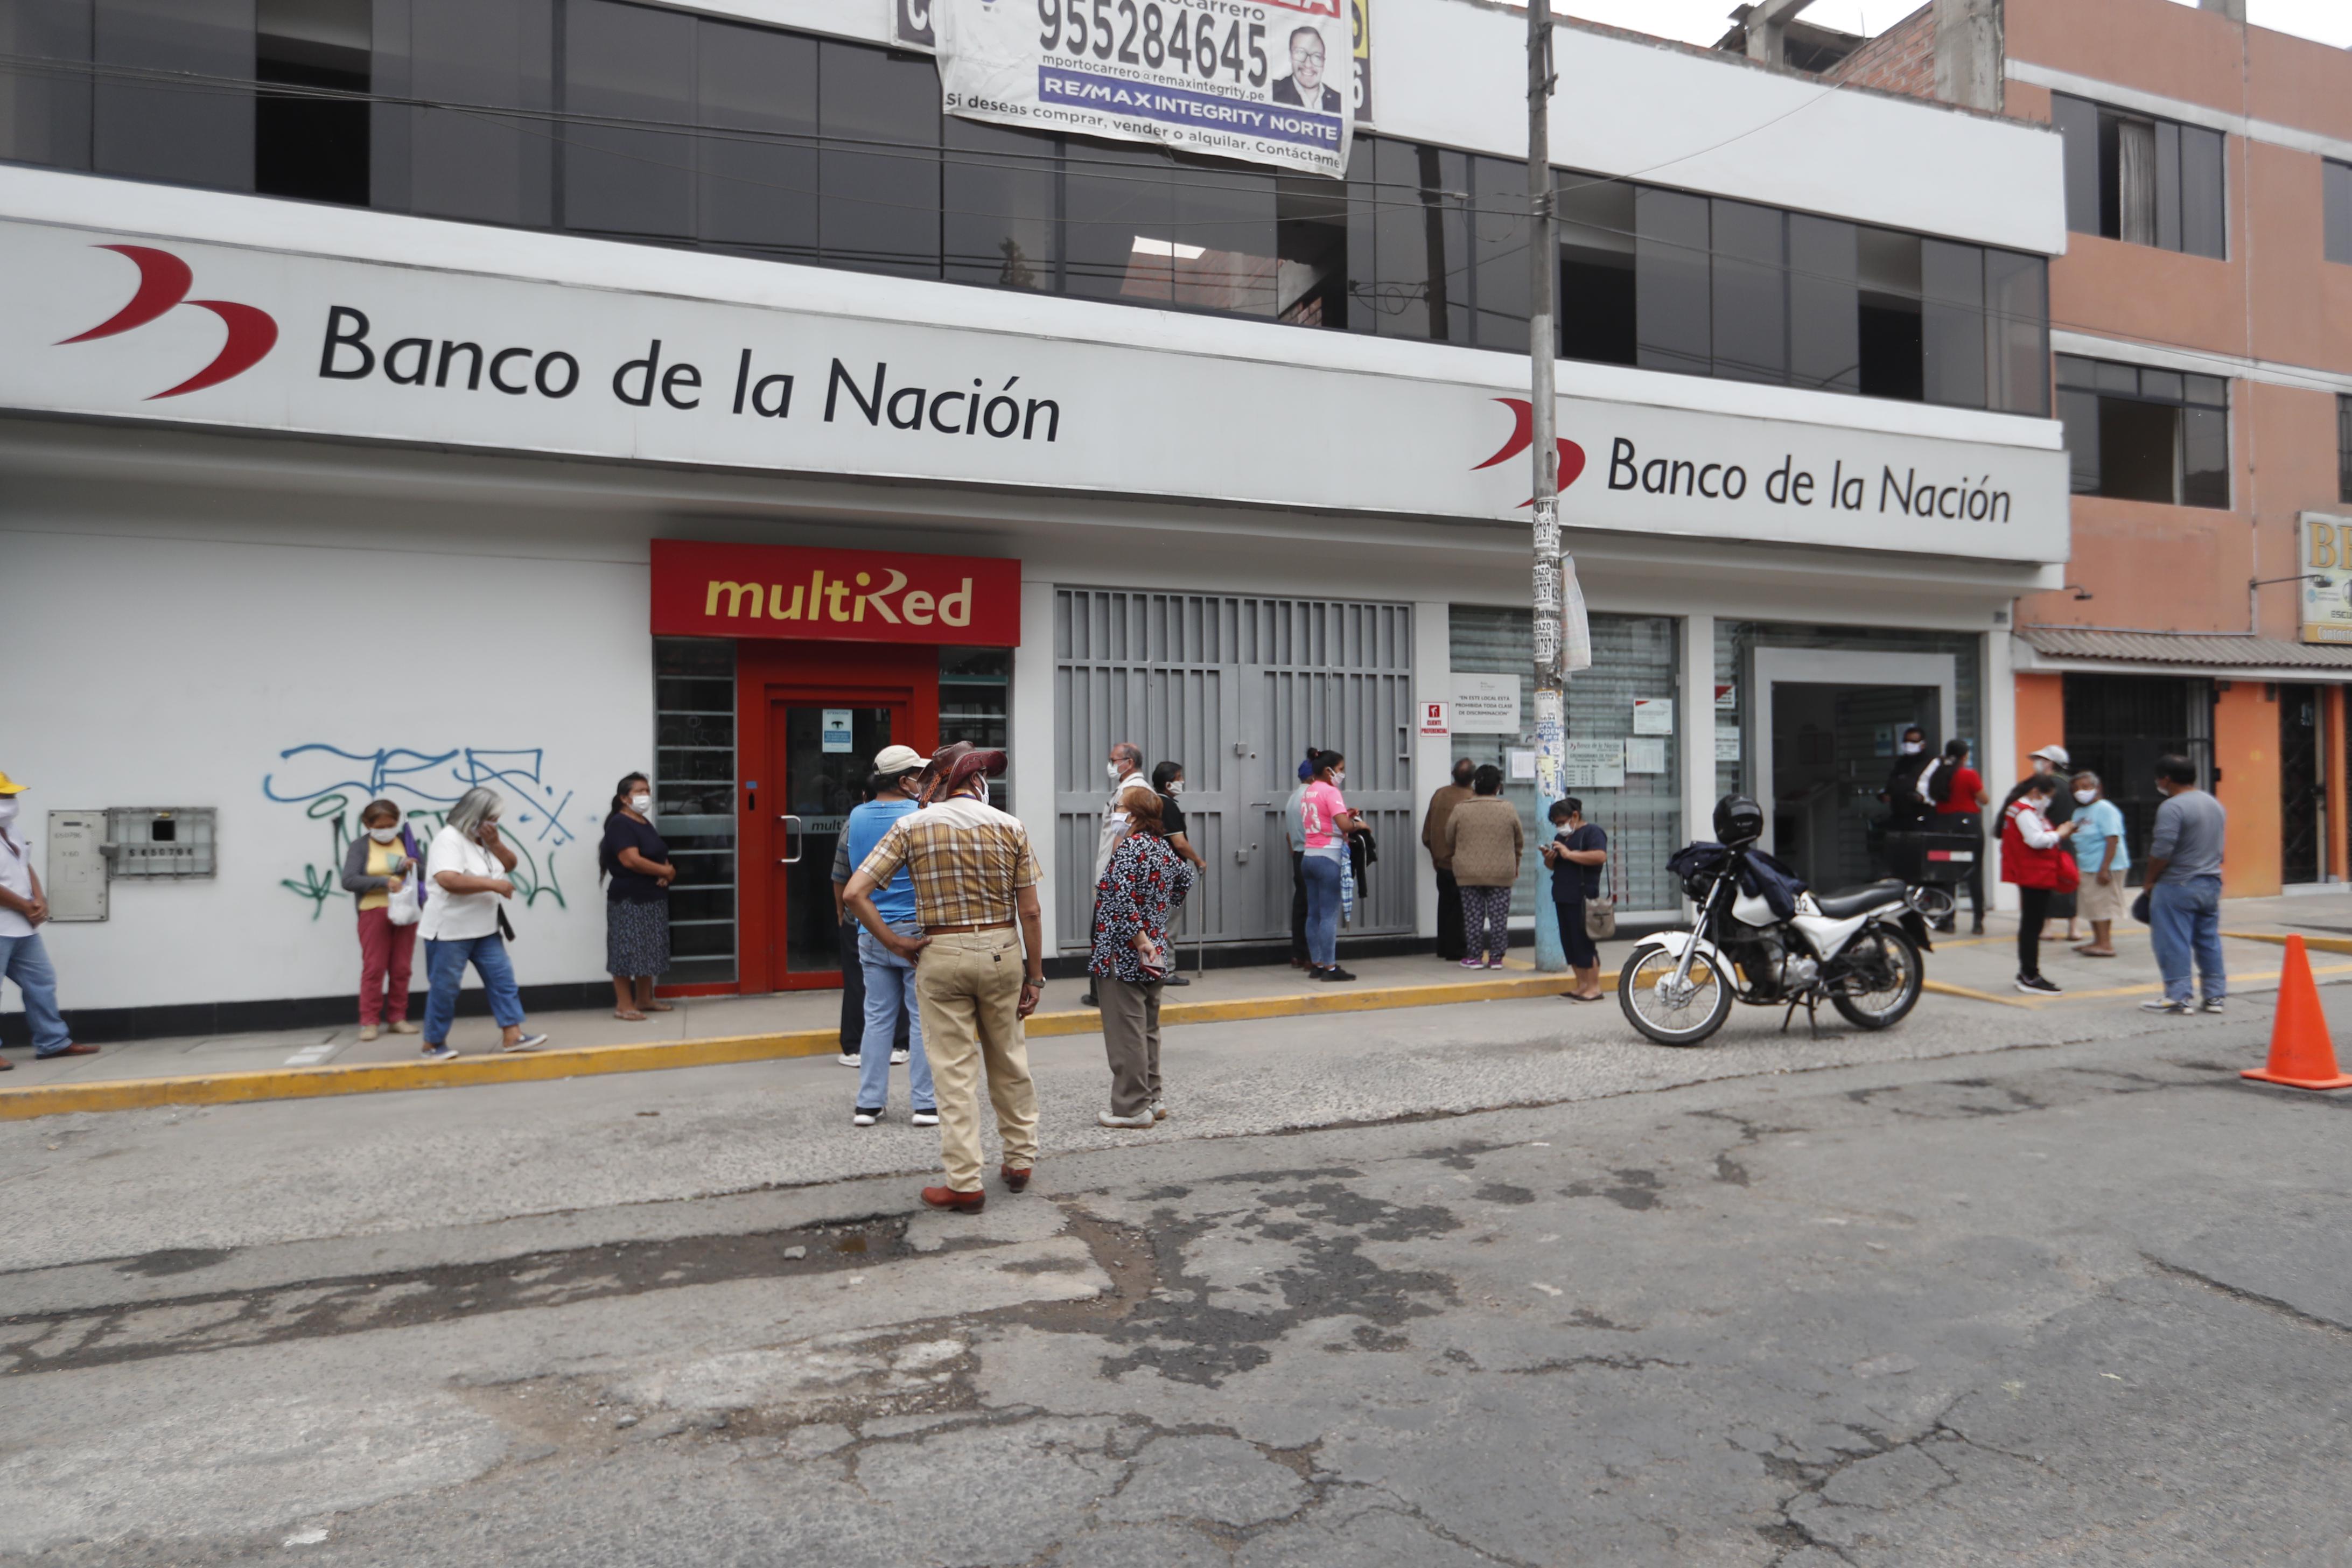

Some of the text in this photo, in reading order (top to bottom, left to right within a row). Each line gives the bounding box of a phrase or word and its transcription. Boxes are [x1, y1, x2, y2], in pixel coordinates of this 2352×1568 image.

[1038, 0, 1267, 88] 955284645
[1042, 54, 1265, 102] mportocarrero@remaxintegrity.pe
[946, 93, 1340, 169] Si deseas comprar, vender o alquilar. Contáctame
[1044, 78, 1338, 141] RE/MAX INTEGRITY NORTE
[319, 305, 1060, 442] Banco de la Nación
[1607, 437, 2011, 523] Banco de la Nación
[704, 568, 972, 627] multiRed
[1301, 802, 1321, 834] 23
